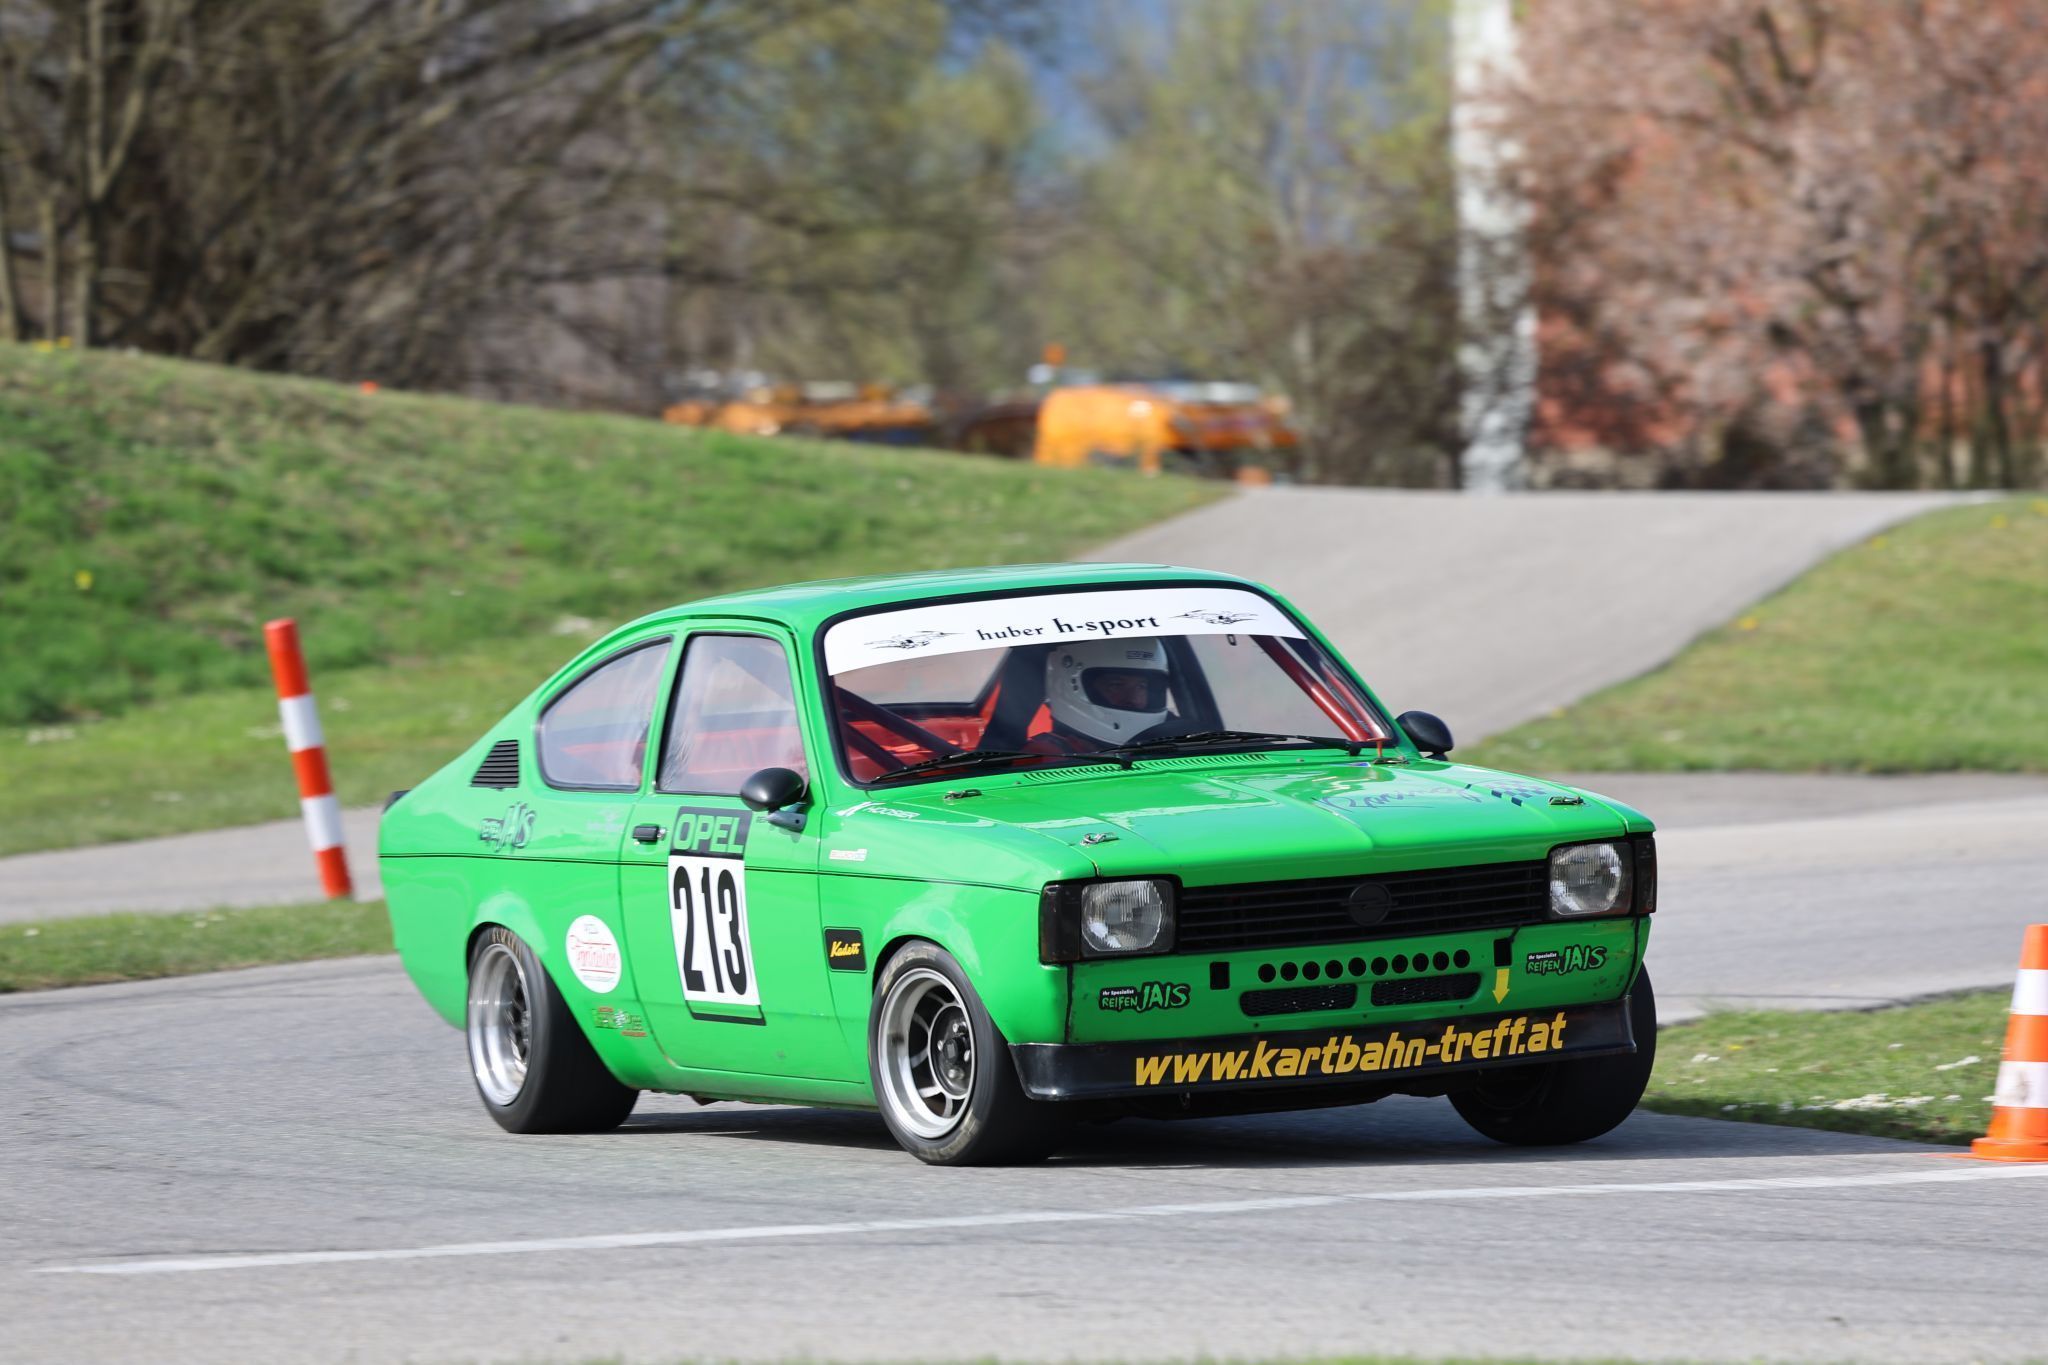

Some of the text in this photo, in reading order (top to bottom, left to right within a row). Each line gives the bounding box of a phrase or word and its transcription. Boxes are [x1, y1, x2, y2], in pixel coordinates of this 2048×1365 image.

[976, 616, 1160, 641] huber h-sport
[672, 813, 745, 854] OPEL
[673, 865, 748, 996] 213
[830, 941, 861, 957] Kadett
[1527, 946, 1607, 974] REIFEN JAIS
[1102, 984, 1188, 1011] REIFEN JAIS
[1135, 1012, 1567, 1086] www.kartbahn-treff.at
